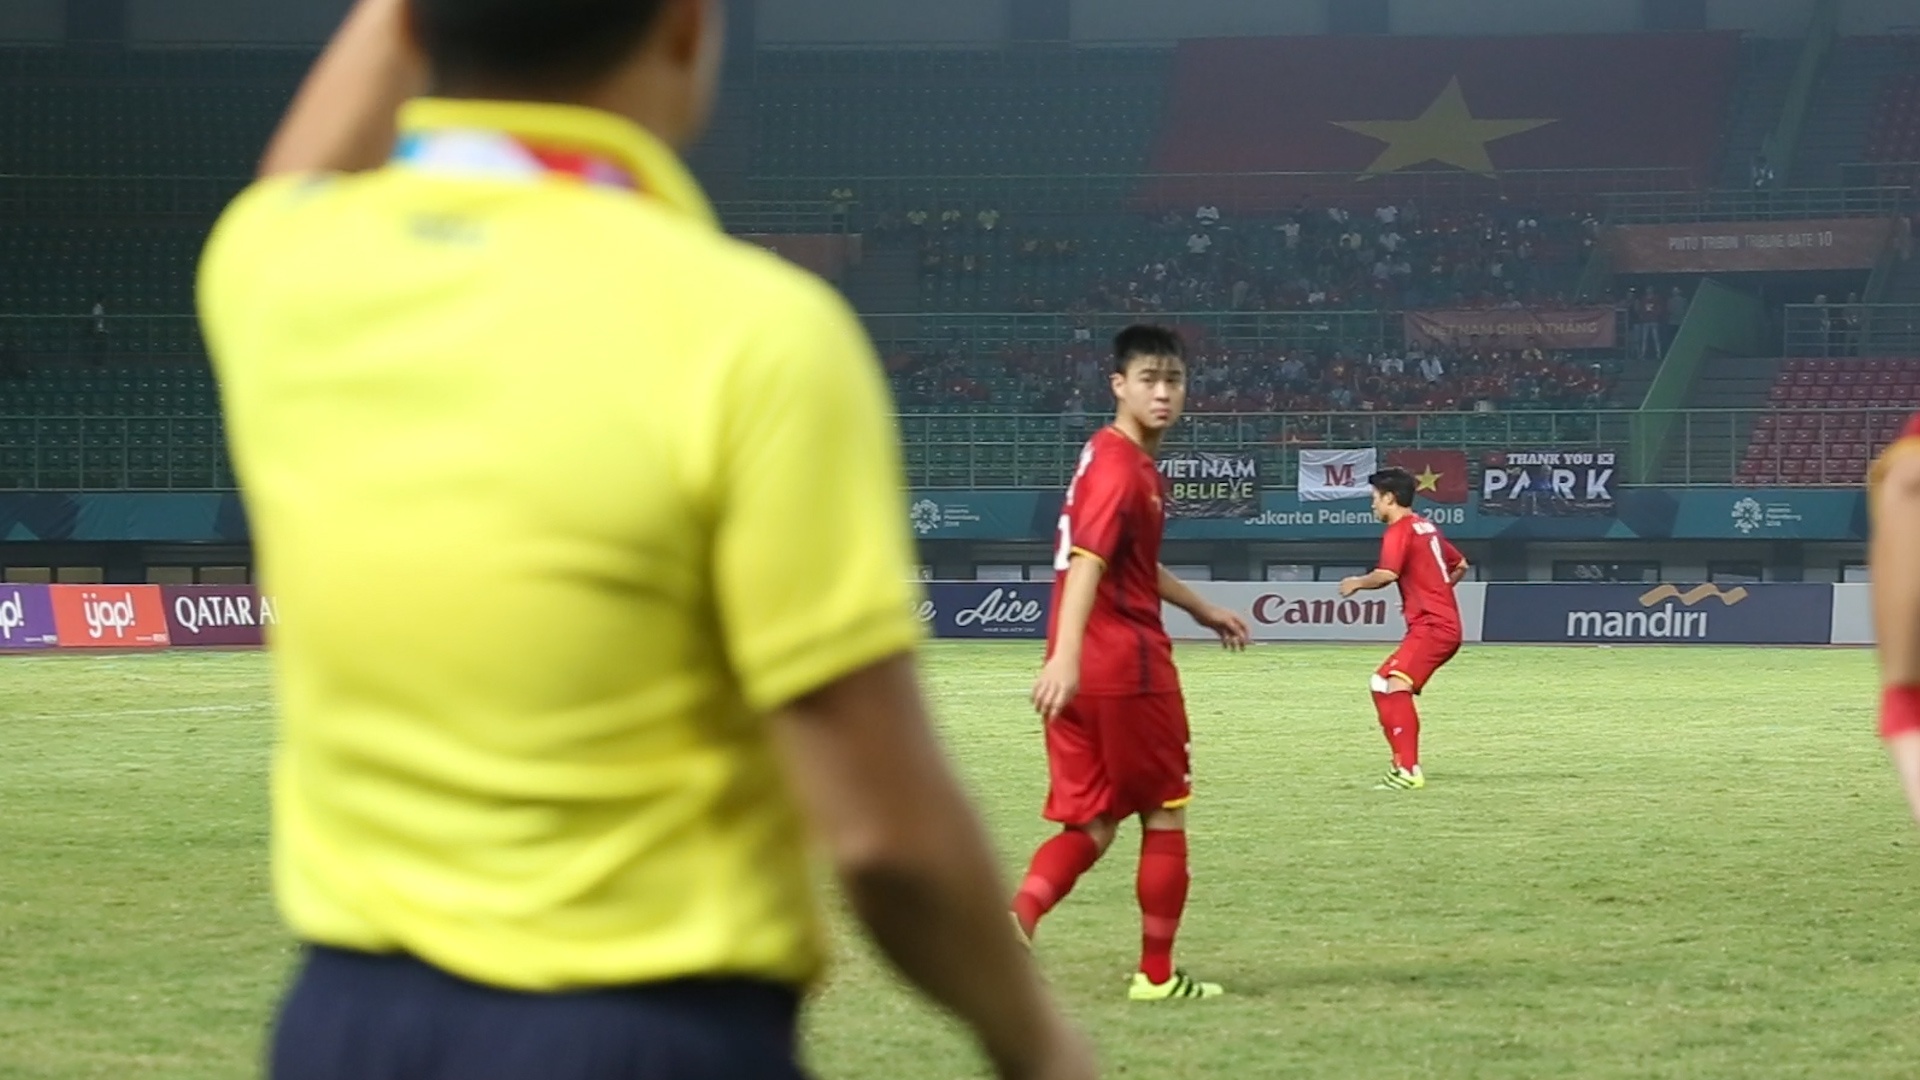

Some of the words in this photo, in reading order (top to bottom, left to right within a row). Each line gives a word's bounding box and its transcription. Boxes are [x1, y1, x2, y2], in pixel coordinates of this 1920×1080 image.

[1787, 233, 1813, 248] GATE
[1818, 230, 1833, 247] 10
[1506, 453, 1560, 465] THANK
[1562, 453, 1593, 465] YOU
[1173, 479, 1254, 500] BELIEVE
[1484, 468, 1614, 500] PARK
[1423, 507, 1465, 525] 2018
[175, 596, 255, 633] QATAR
[955, 588, 1042, 626] Aice
[1252, 593, 1387, 625] Canon
[1567, 603, 1707, 638] mandiri
